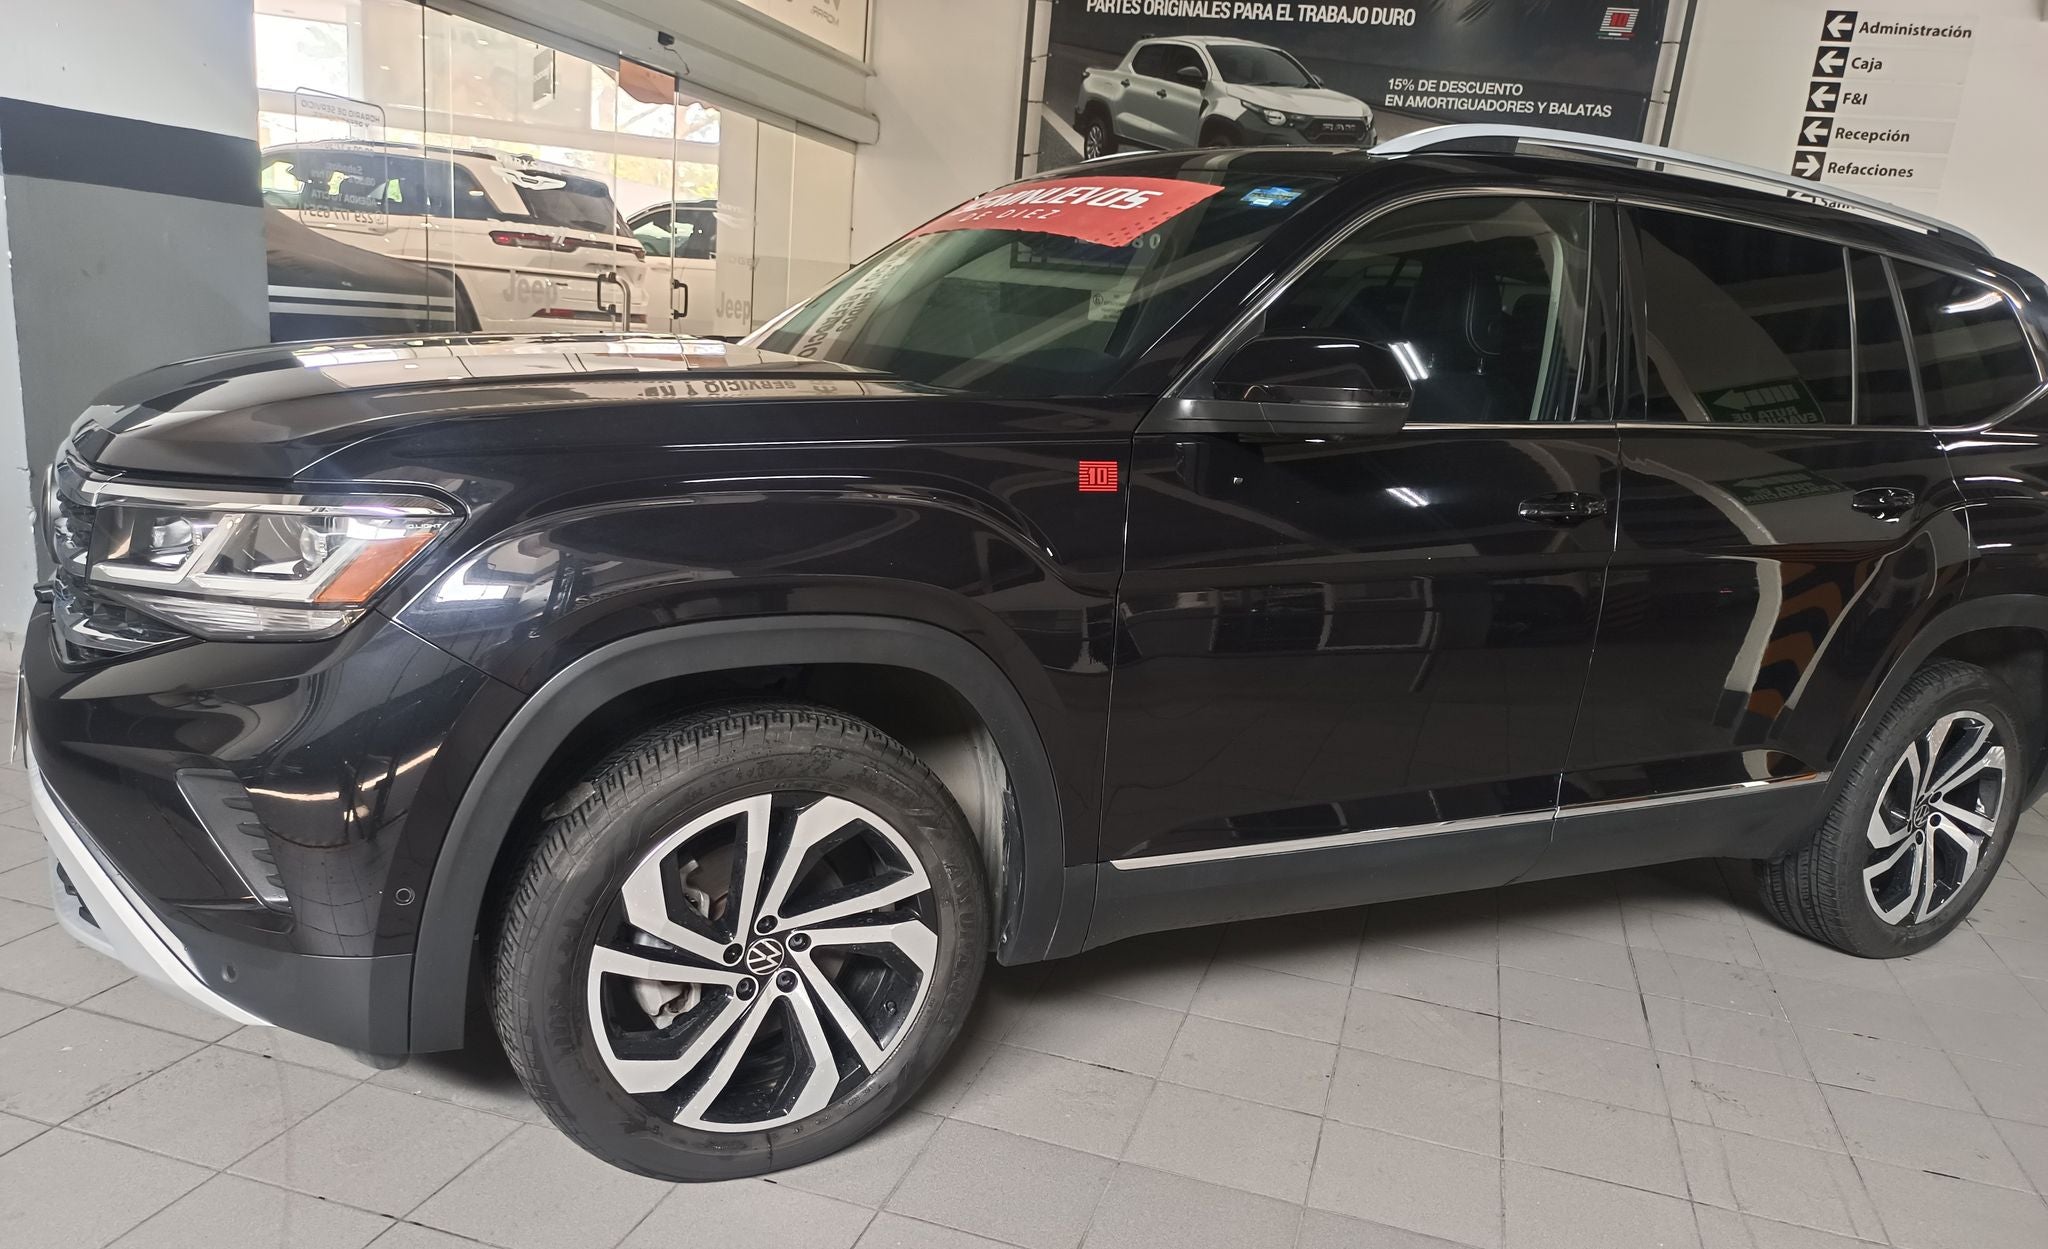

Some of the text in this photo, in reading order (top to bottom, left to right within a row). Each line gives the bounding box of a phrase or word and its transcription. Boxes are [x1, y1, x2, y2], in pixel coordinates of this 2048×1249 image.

[1086, 0, 1417, 26] PARTES ORIGINALES PARA EL TRABAJO DURO
[1859, 21, 1973, 39] Administración
[1851, 57, 1883, 73] Caja
[1389, 78, 1523, 96] 15% DE DESCUENTO
[1384, 94, 1613, 118] EN AMORTIGUADORES Y BALATAS
[1842, 92, 1868, 106] F&I
[1835, 127, 1911, 143] Recepción
[1827, 161, 1914, 178] Refacciones
[995, 209, 1061, 220] DIEZ
[503, 270, 559, 313] Jeep
[716, 292, 751, 326] Jeep
